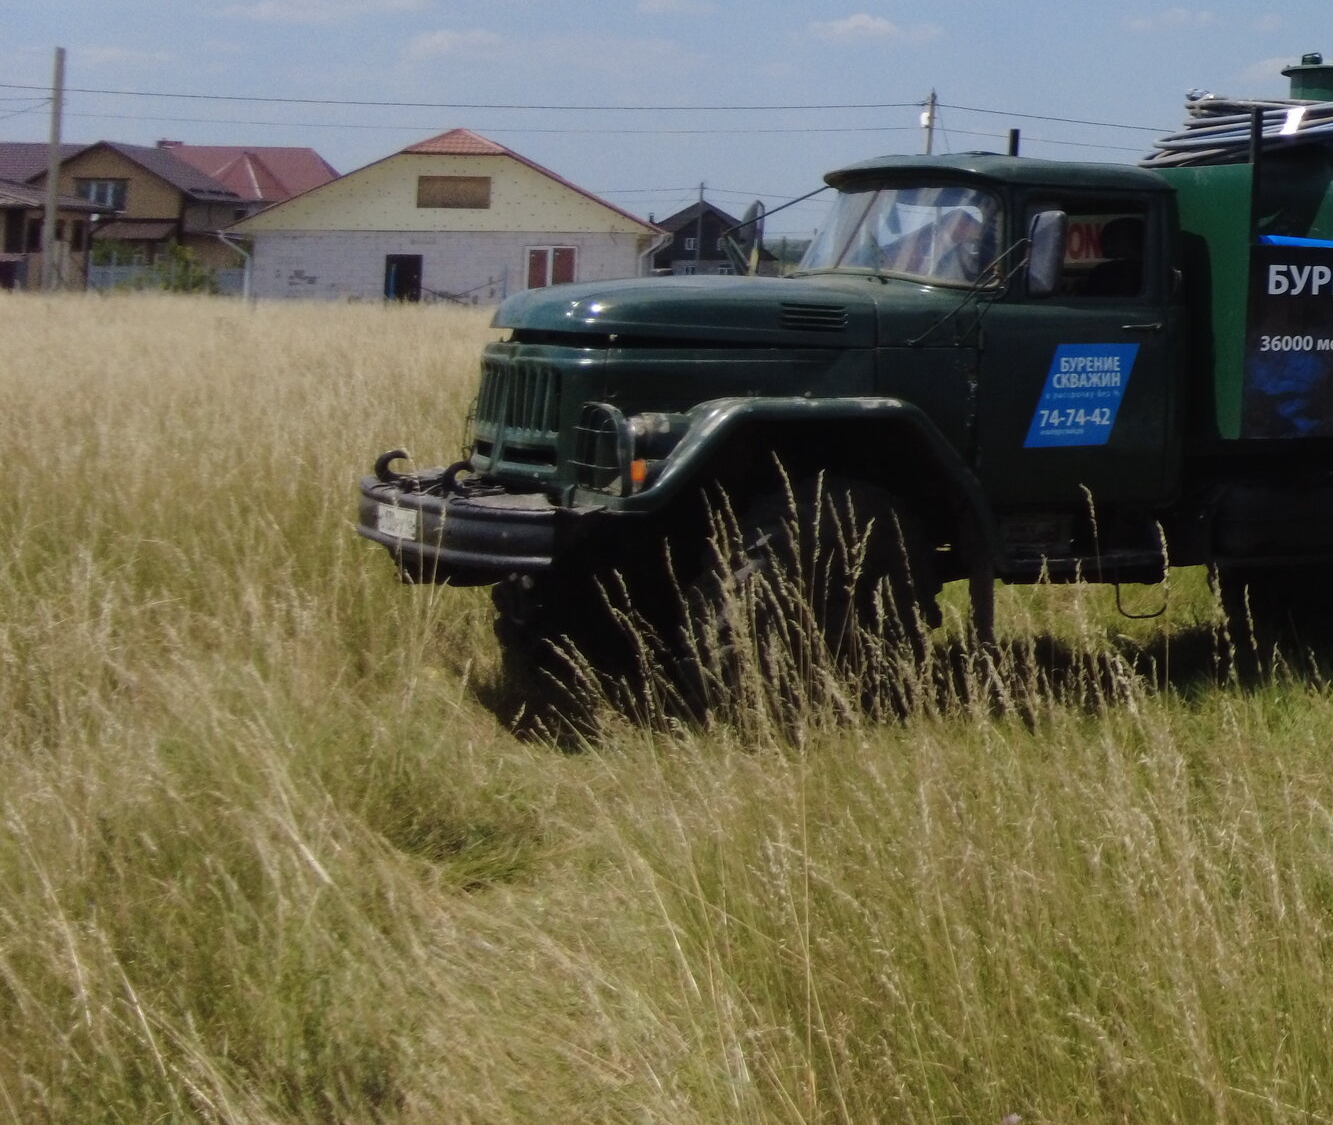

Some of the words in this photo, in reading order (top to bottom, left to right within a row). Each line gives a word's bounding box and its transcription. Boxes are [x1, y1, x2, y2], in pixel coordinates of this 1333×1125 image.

[1260, 335, 1314, 352] 36000
[1060, 356, 1121, 372] БУРЕНИЕ
[1053, 372, 1121, 389] СКВАЖИН
[1040, 408, 1111, 427] 74-74-42
